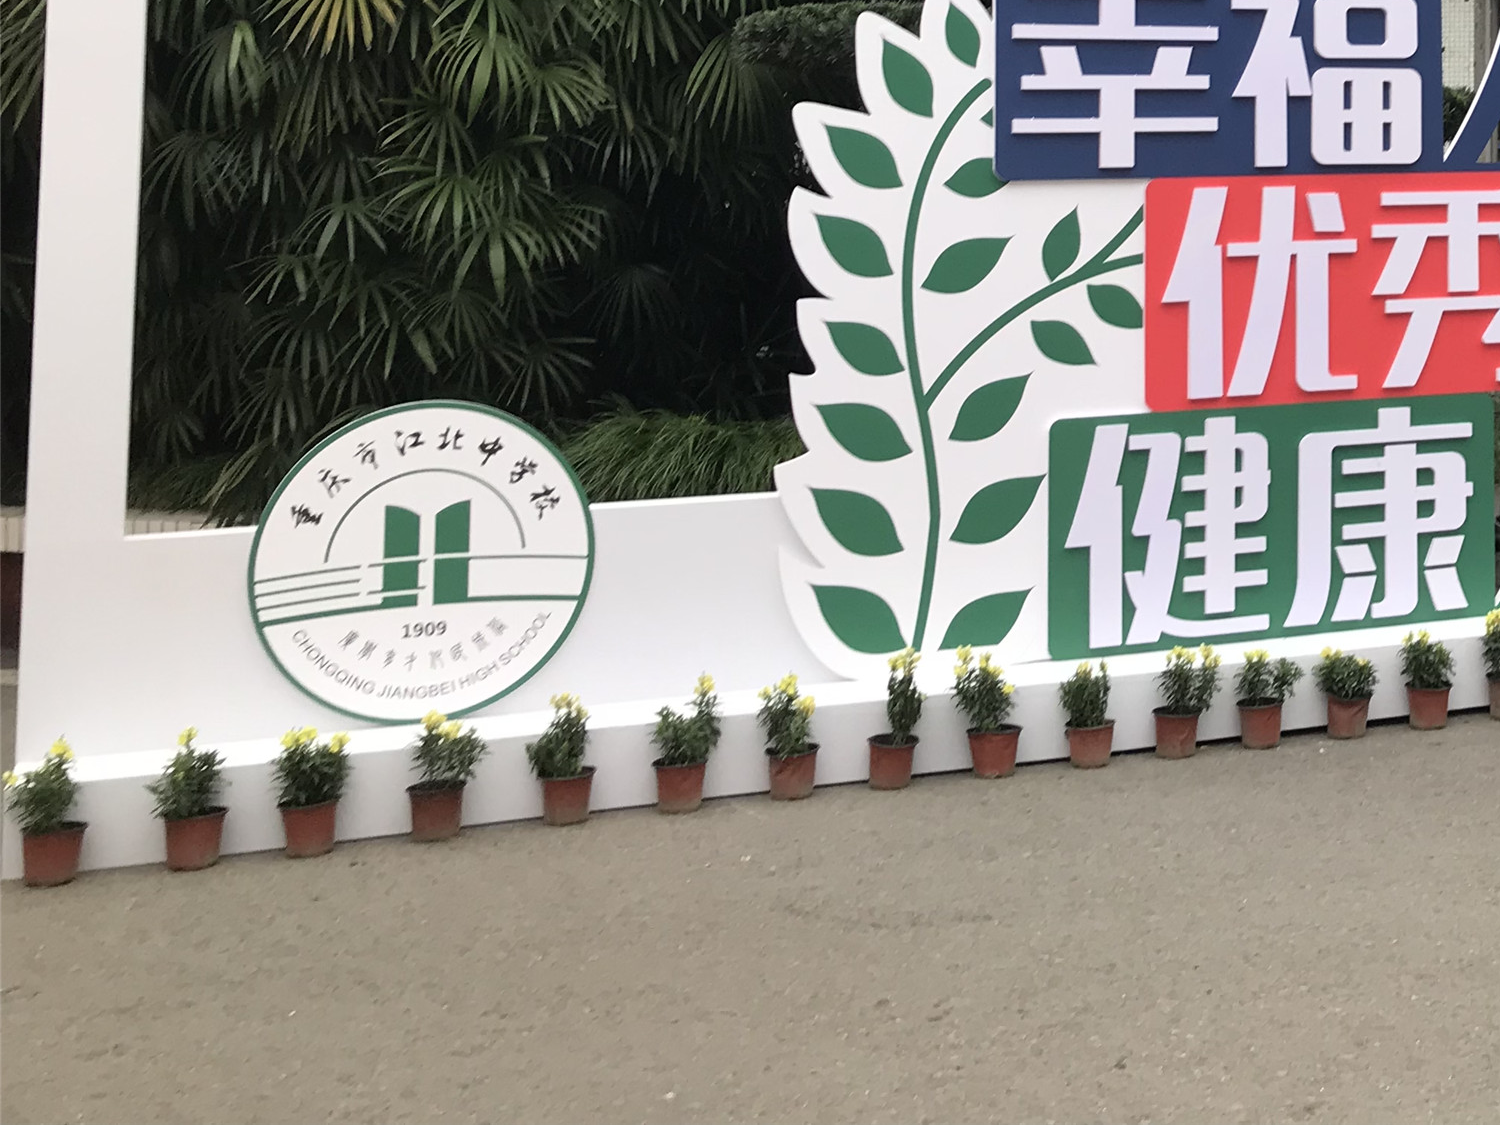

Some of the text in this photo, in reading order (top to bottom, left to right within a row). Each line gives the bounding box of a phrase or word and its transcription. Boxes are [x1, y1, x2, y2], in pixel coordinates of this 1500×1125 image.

[401, 620, 448, 638] 1909
[292, 628, 376, 695] CHONGQING
[376, 680, 456, 700] JIANGBEI
[458, 661, 500, 689] HIGH
[499, 612, 552, 666] SCHOOL
